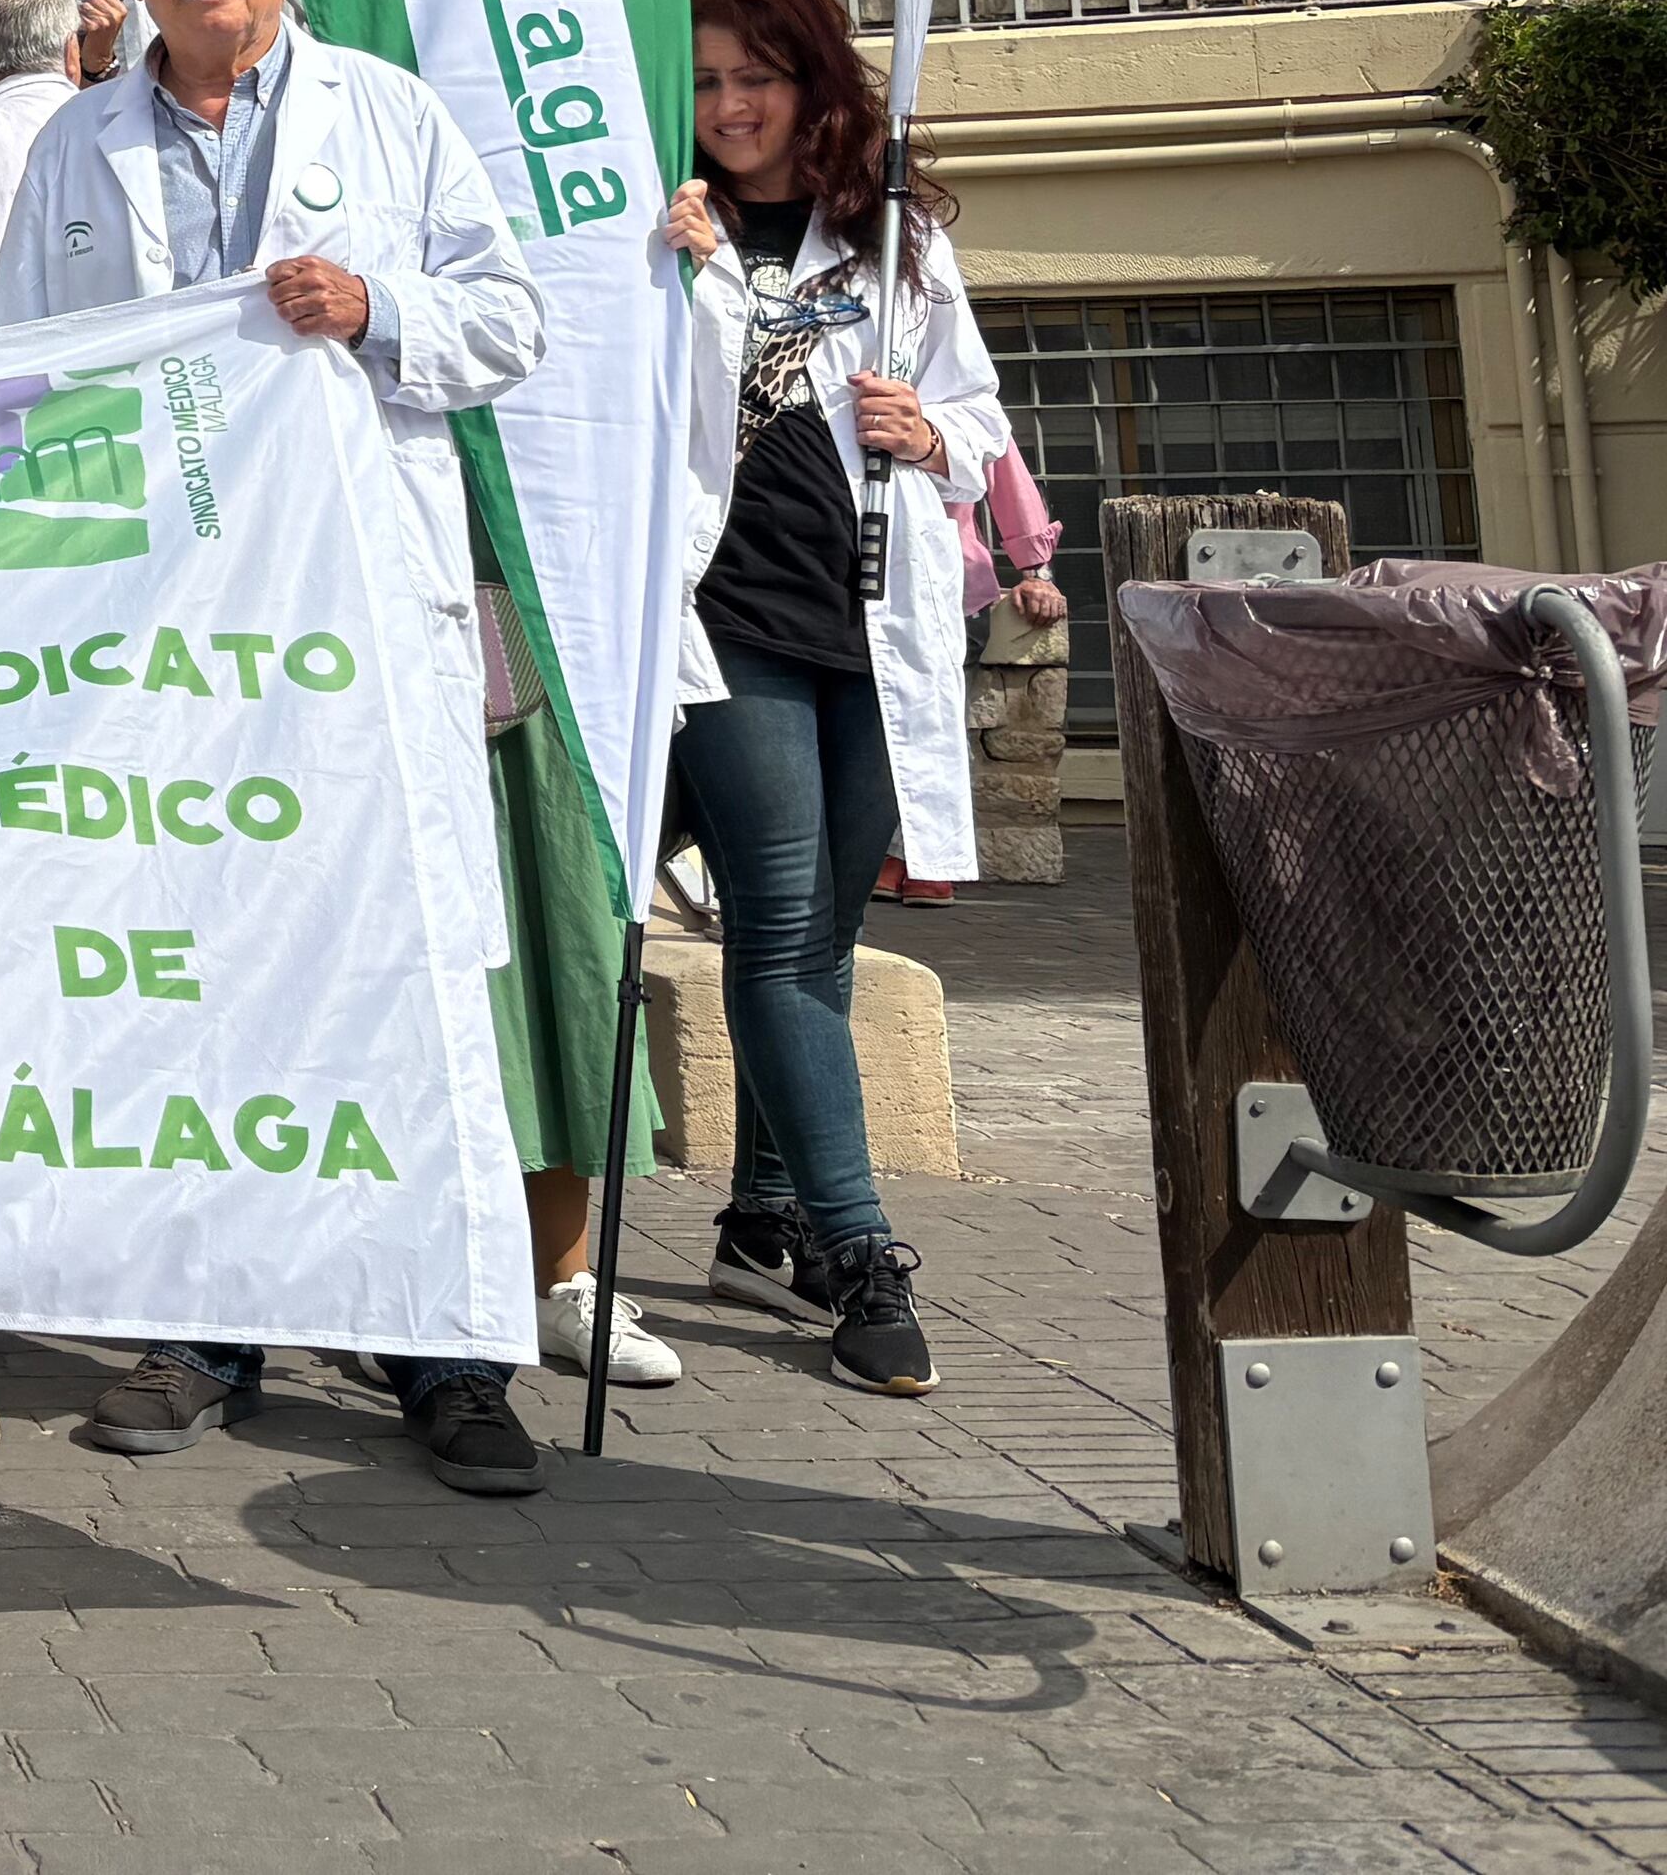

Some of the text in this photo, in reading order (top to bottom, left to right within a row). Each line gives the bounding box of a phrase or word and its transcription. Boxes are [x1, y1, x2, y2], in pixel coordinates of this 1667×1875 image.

[160, 357, 221, 539] SINDICATO MÉDICO
[53, 925, 202, 1002] DE
